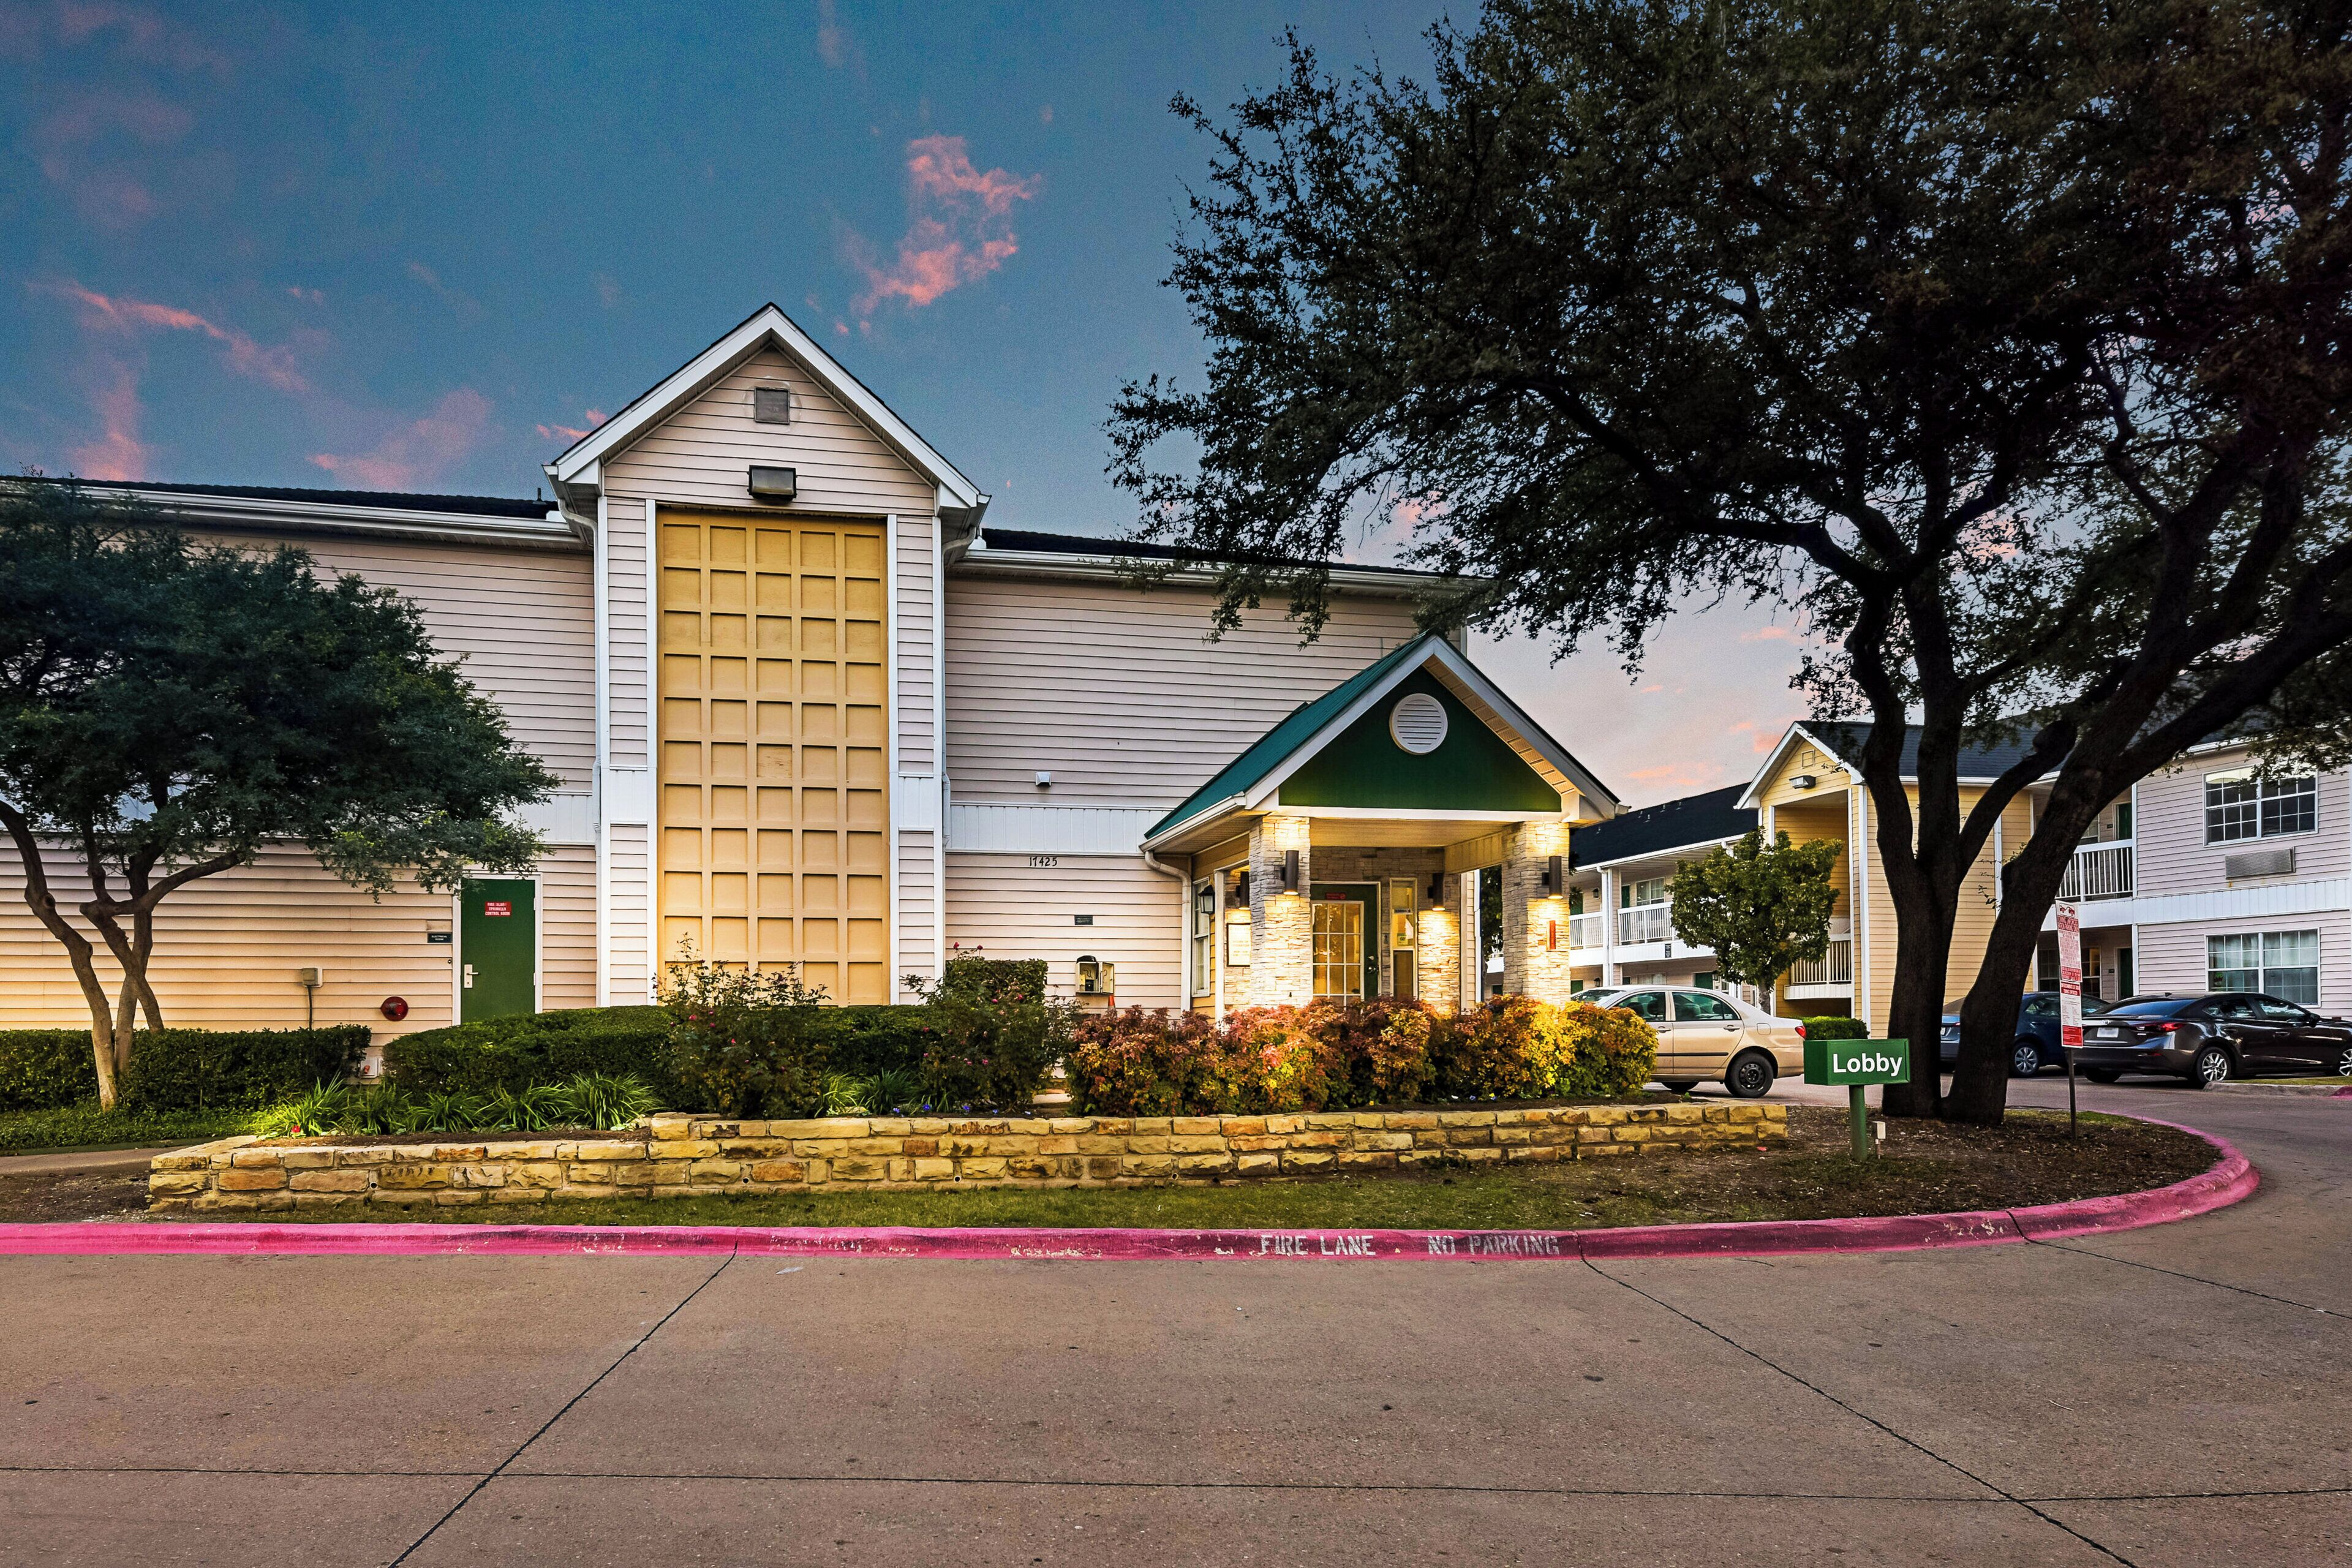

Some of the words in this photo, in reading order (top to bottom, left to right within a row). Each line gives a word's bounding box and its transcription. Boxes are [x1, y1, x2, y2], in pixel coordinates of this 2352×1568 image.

[1029, 856, 1057, 867] 17425
[1833, 1053, 1902, 1077] Lobby
[1259, 1234, 1308, 1256] FIRE
[1320, 1235, 1376, 1256] LANE
[1428, 1235, 1456, 1256] NO
[1469, 1235, 1560, 1256] PARKING
